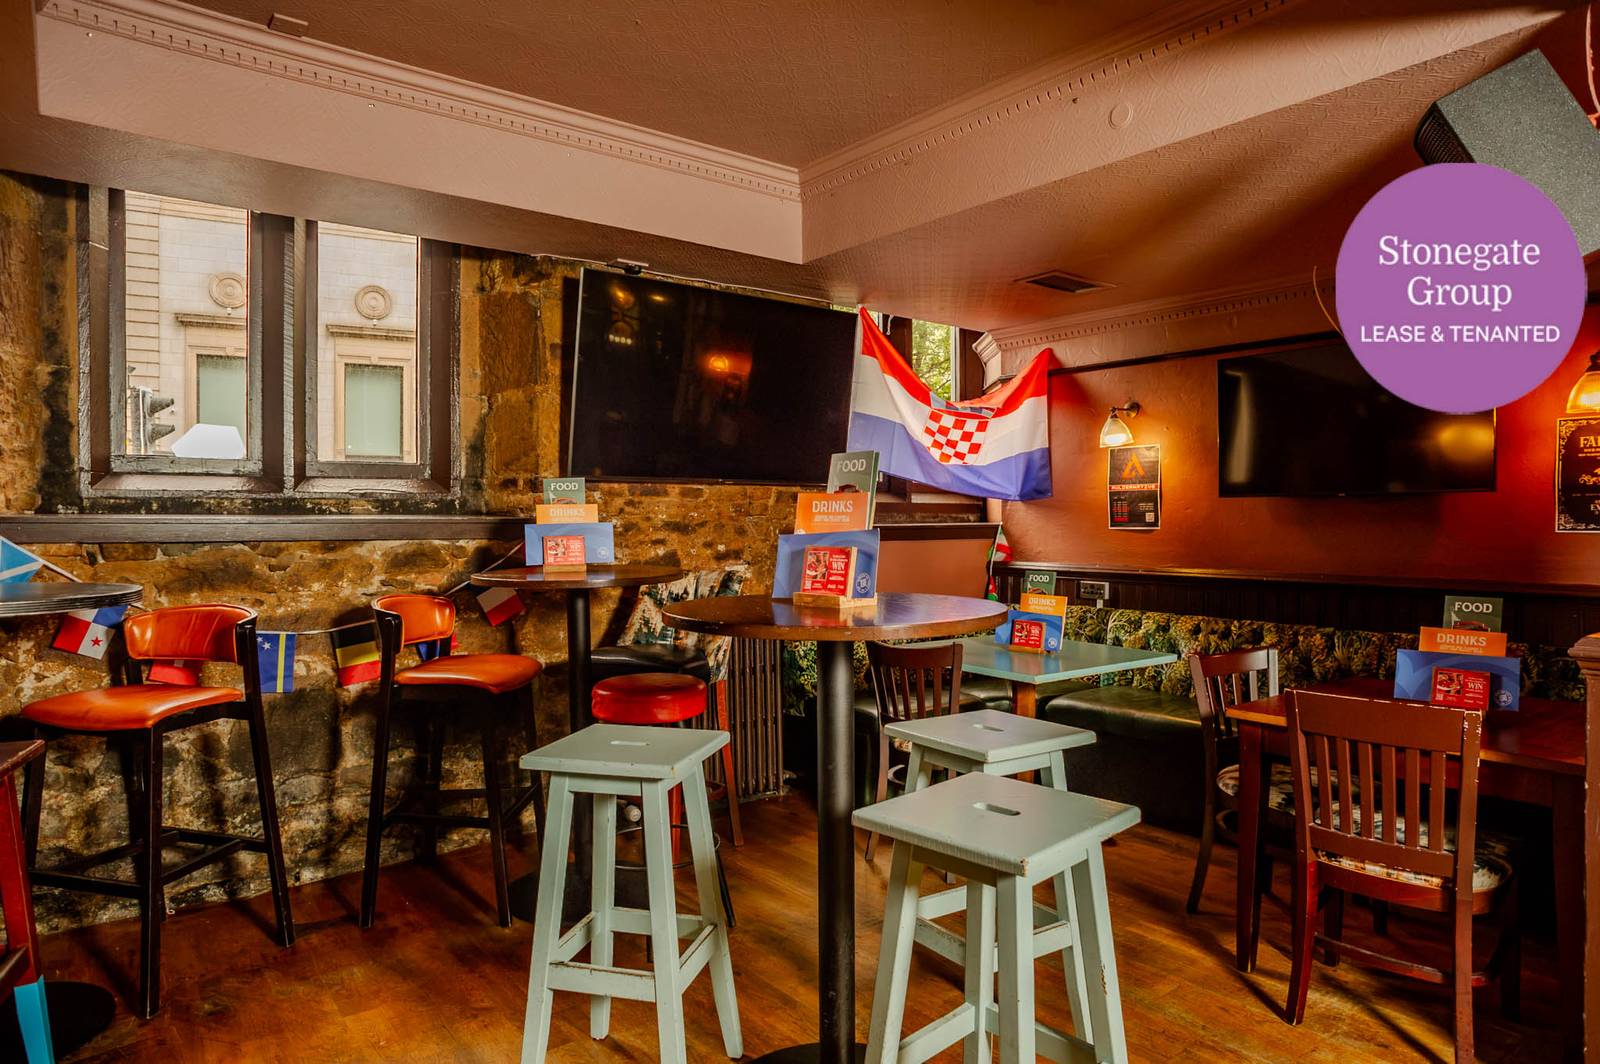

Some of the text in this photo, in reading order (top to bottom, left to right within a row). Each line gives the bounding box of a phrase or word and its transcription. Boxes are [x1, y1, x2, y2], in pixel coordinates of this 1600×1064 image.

[837, 459, 866, 472] FOOD
[550, 482, 578, 491] FOOD
[812, 500, 853, 512] DRINKS
[550, 508, 585, 517] DRINKS
[832, 561, 846, 571] WIN
[1029, 574, 1050, 583] FOOD
[1028, 597, 1057, 607] DRINKS
[1454, 601, 1493, 614] FOOD
[1436, 632, 1487, 646] DRINKS
